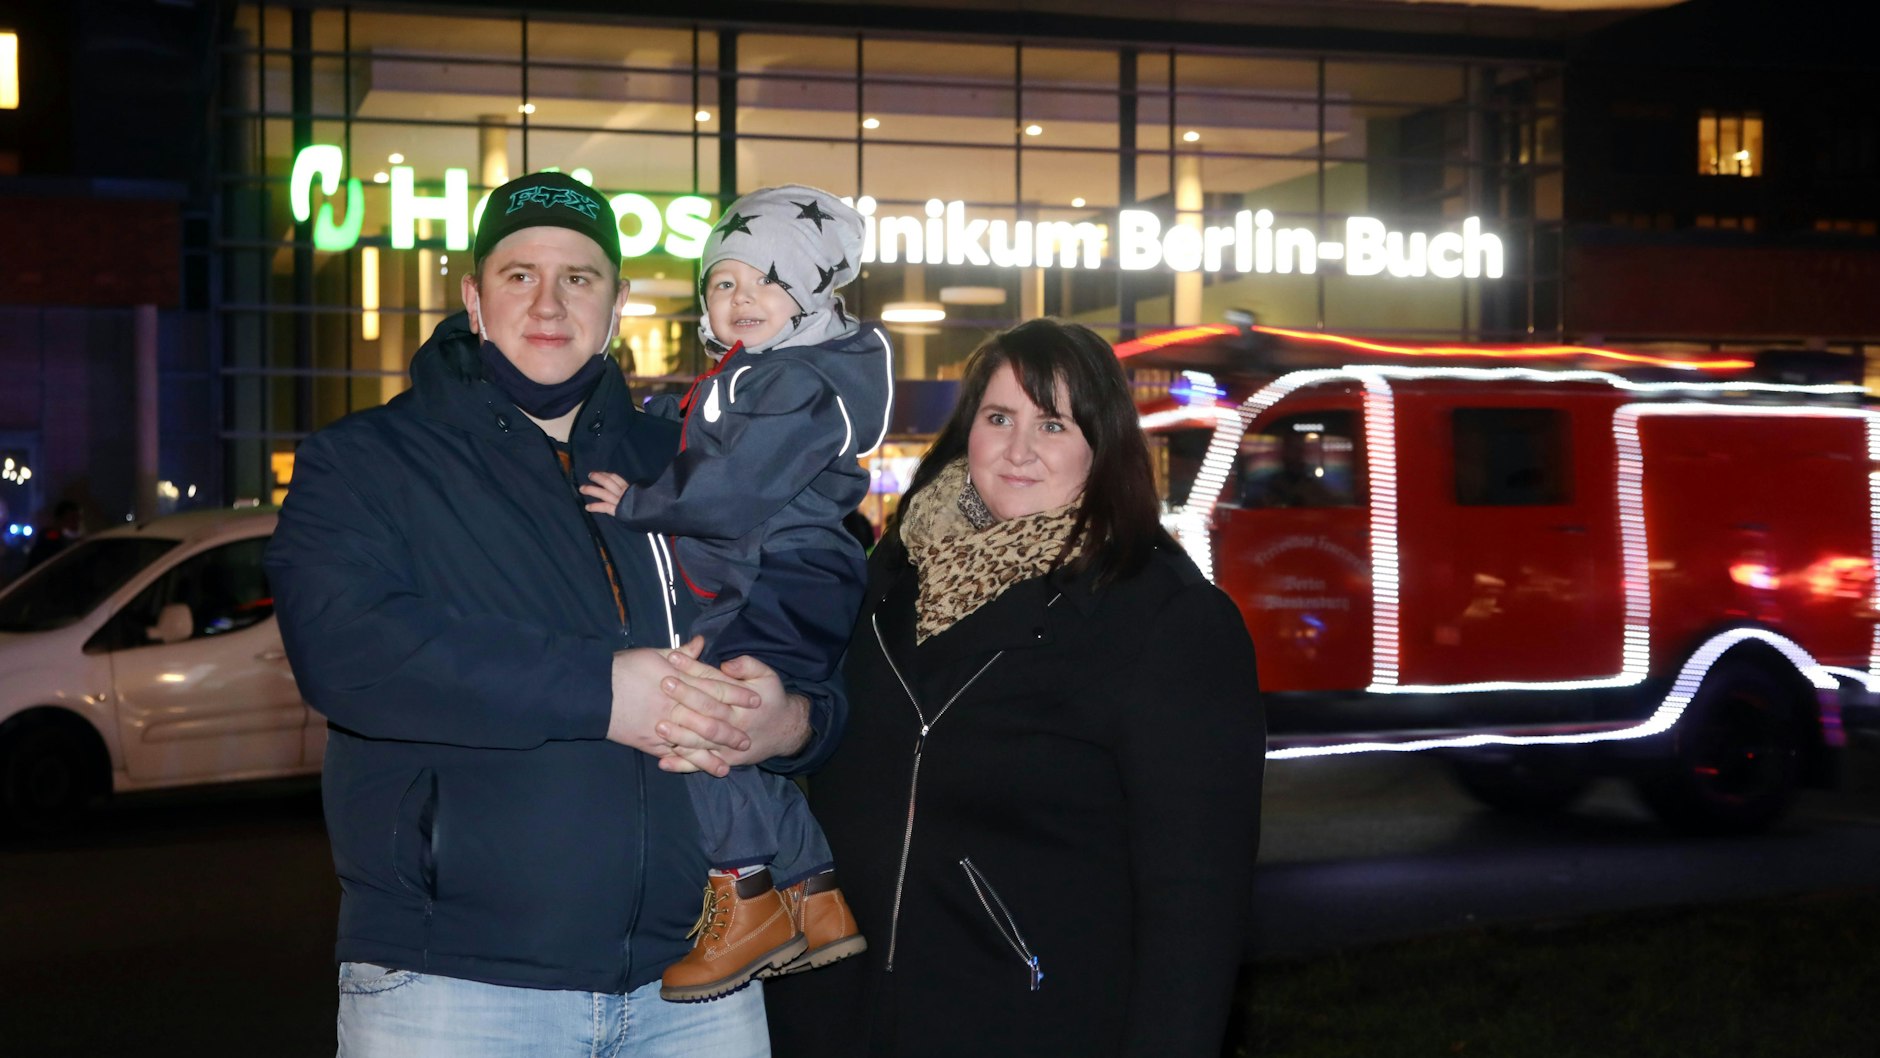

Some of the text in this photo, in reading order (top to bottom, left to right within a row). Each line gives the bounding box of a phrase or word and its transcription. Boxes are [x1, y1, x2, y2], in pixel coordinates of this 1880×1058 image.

[389, 166, 1504, 279] Hos inikum Berlin-Buch
